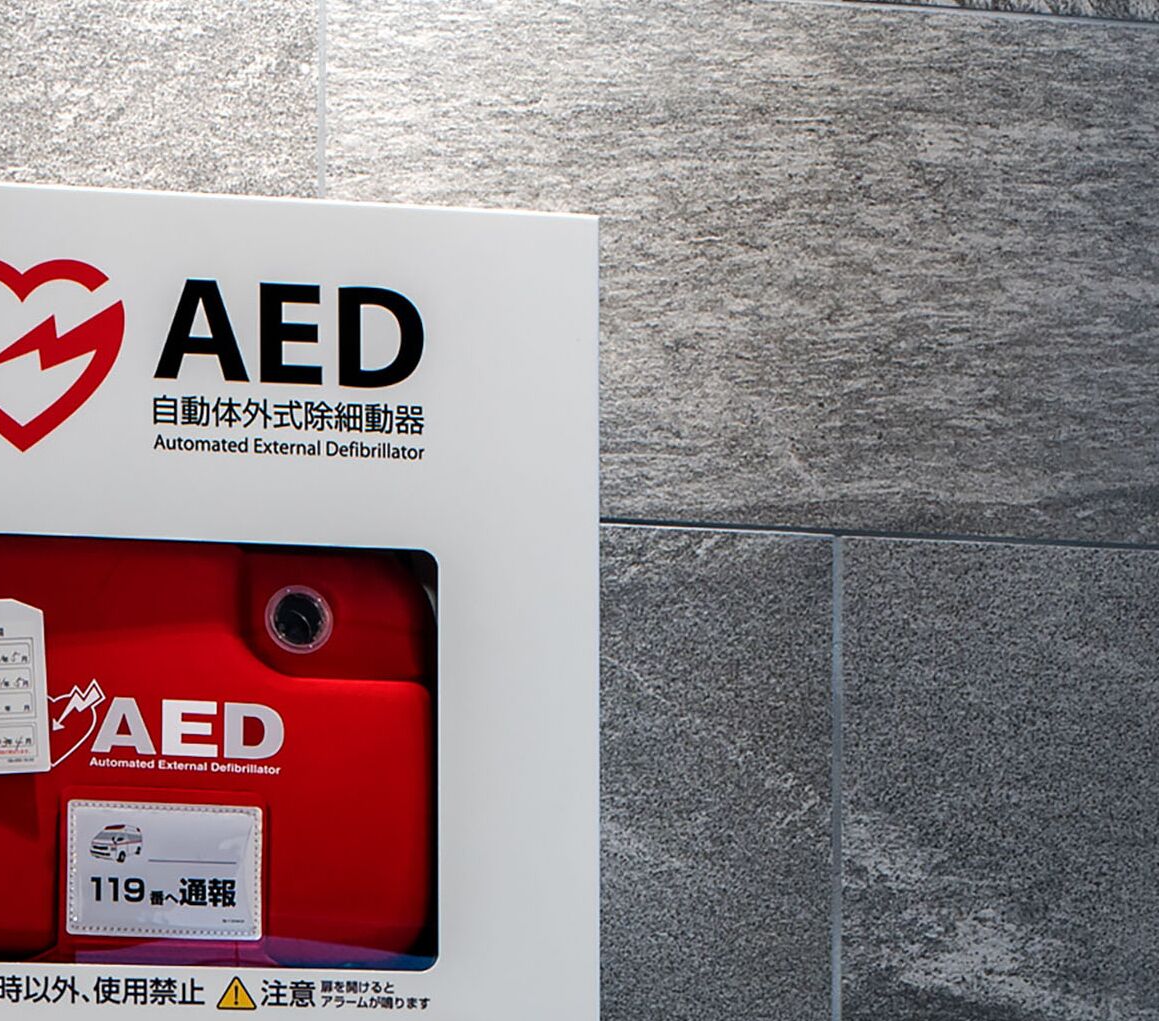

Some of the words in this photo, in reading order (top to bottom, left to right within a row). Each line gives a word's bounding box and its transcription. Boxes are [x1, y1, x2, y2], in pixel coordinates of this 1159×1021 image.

[153, 279, 425, 389] AED
[153, 395, 425, 435] 自動体外式除細動器
[153, 434, 249, 454] Automated
[254, 438, 321, 456] External
[326, 440, 425, 460] Defibrillator
[90, 696, 284, 760] AED
[89, 756, 155, 769] Automated
[158, 759, 208, 772] External
[211, 763, 281, 775] Defibrillator
[261, 979, 316, 1008] 注意
[320, 980, 395, 994] 扉を開けると
[321, 995, 431, 1010] アラームが鳴ります
